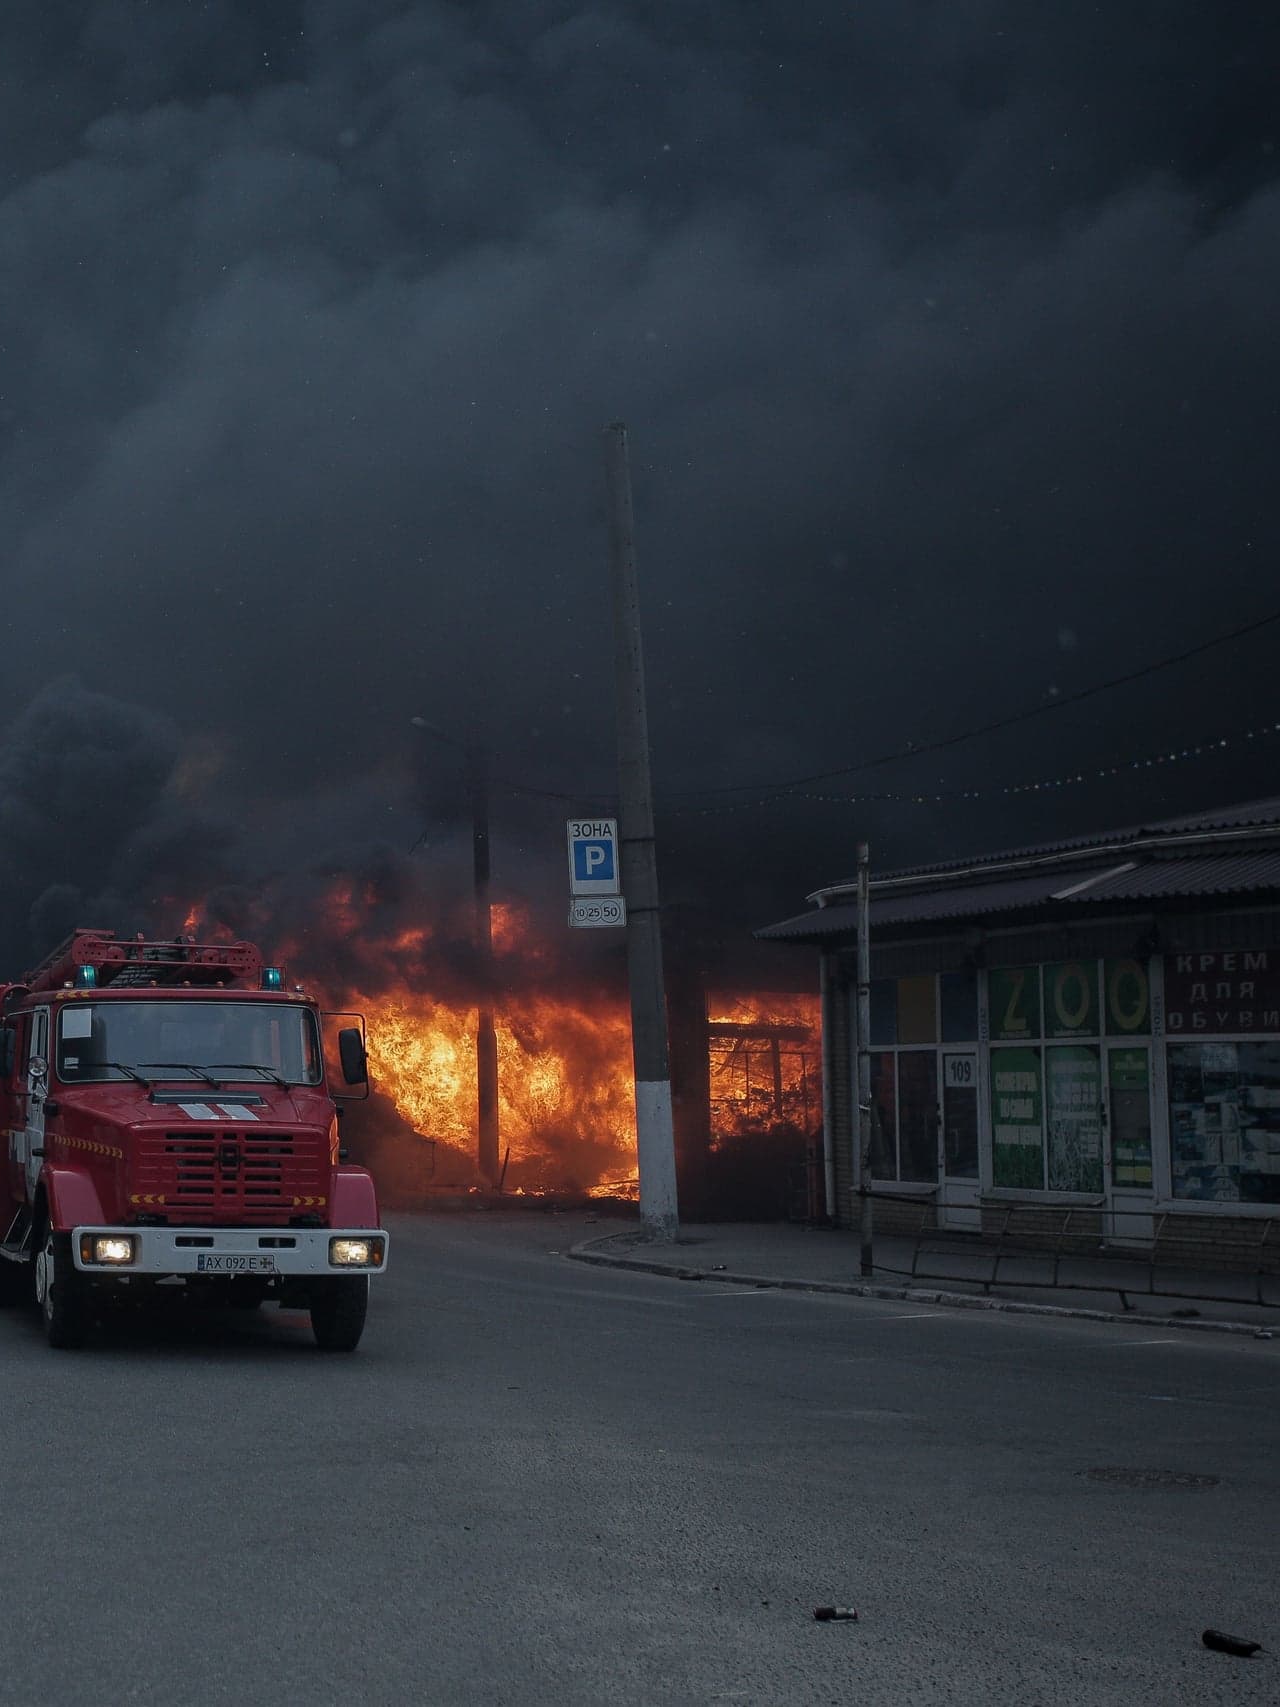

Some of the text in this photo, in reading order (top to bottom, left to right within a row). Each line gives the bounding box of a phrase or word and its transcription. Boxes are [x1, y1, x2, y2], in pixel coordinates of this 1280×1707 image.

[572, 823, 612, 838] ЗОНА
[585, 846, 605, 875] P
[588, 908, 600, 917] 25
[603, 906, 618, 917] 50
[1176, 952, 1268, 974] КРЕМ
[1002, 960, 1148, 1031] ZOO
[1190, 981, 1256, 1003] ДЛЯ
[1167, 1009, 1280, 1030] ОБУВИ
[951, 1061, 971, 1082] 109
[206, 1257, 222, 1269] AX
[226, 1257, 246, 1269] 092
